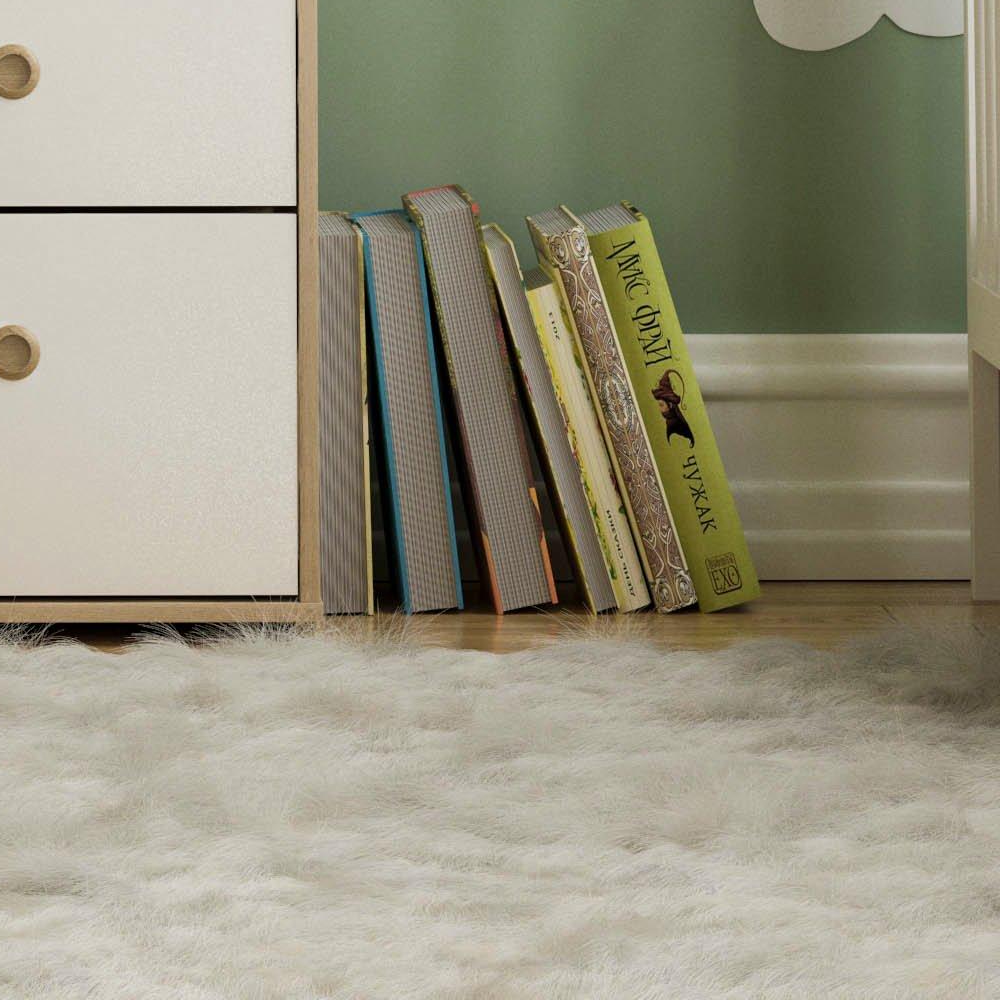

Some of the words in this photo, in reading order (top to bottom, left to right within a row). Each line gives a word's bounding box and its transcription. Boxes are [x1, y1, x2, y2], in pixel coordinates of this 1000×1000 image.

[606, 237, 651, 301] МАКС
[631, 303, 673, 369] ФРАЙ
[682, 455, 718, 534] ЧУЖАК
[606, 508, 624, 561] СКАЗКИ
[622, 561, 636, 597] ДЕНЬ
[711, 564, 741, 591] ЕХО
